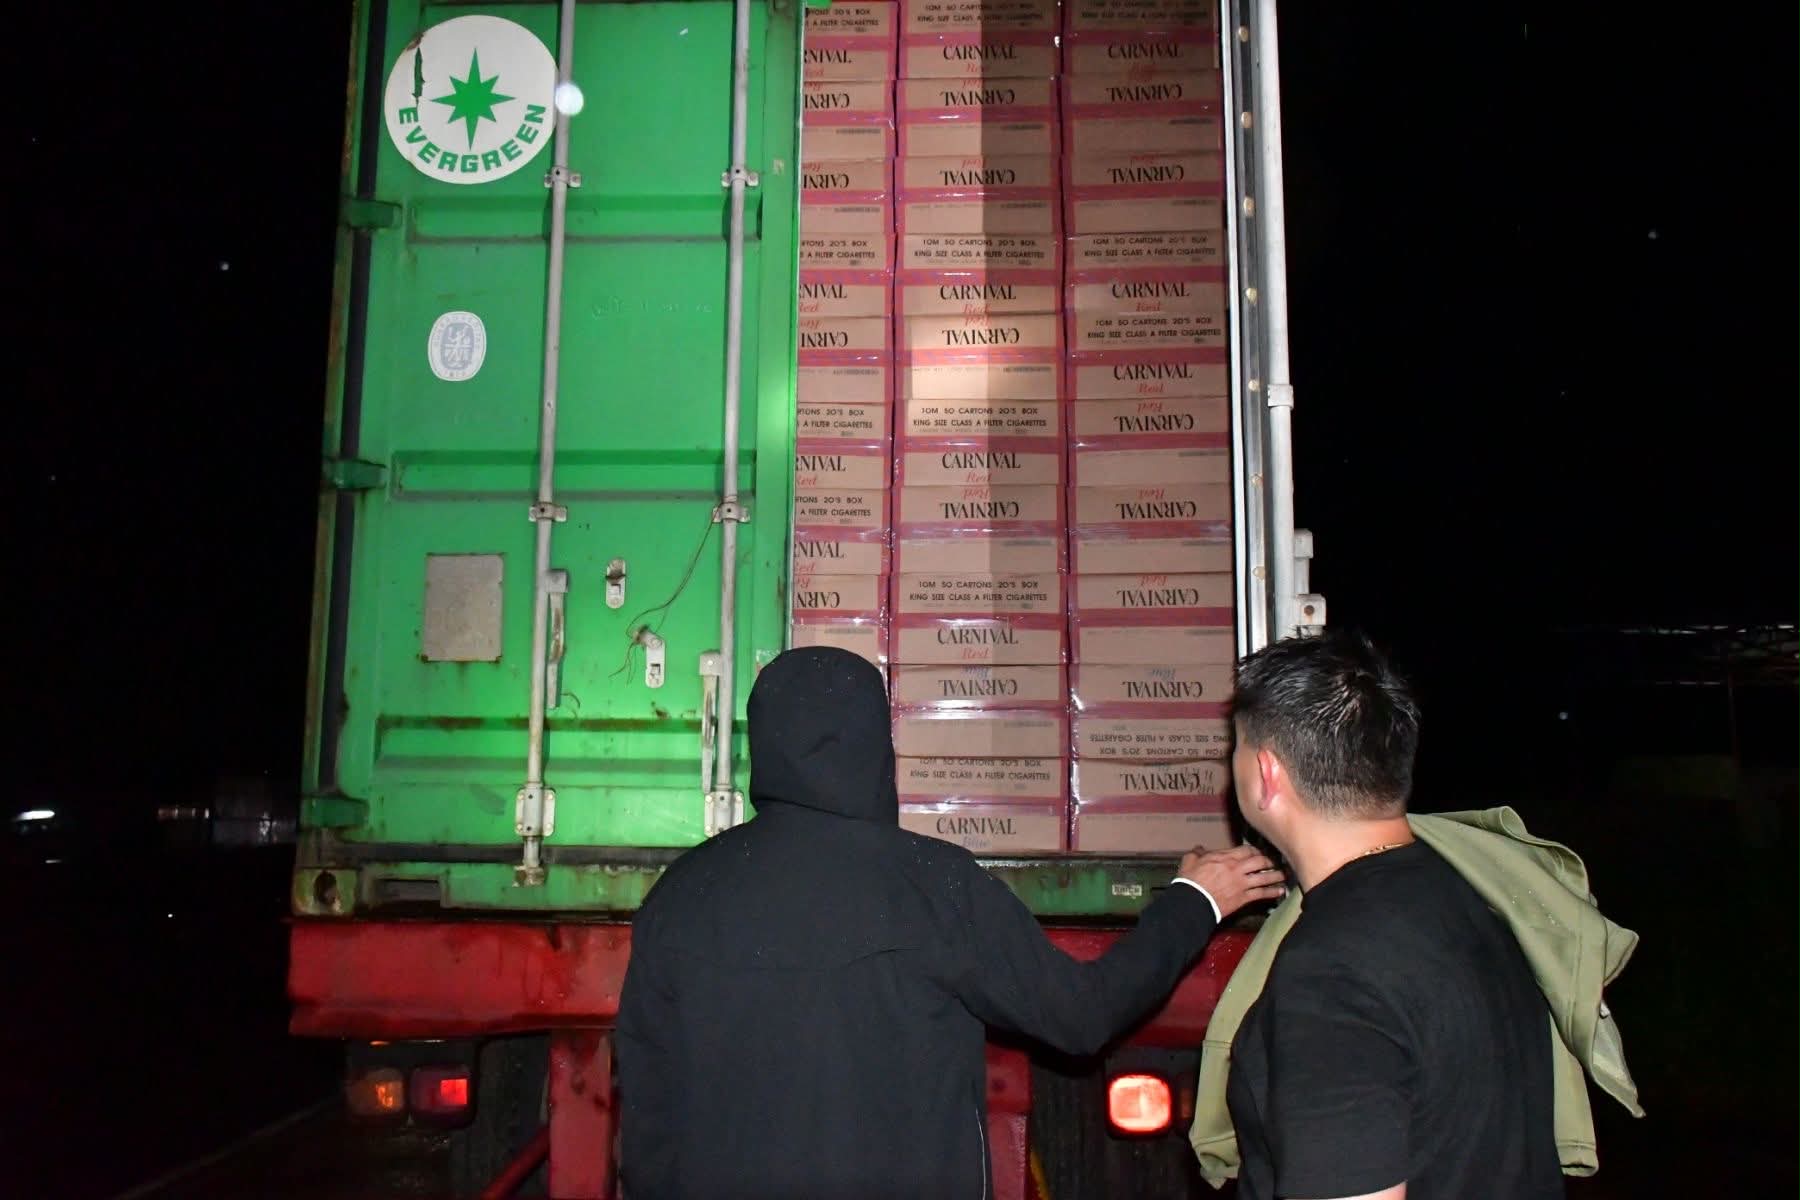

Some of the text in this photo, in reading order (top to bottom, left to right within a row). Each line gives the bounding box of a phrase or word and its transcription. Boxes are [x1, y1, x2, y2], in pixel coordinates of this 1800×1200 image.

[943, 45, 1017, 61] CARNIVAL
[1108, 42, 1184, 59] CARNIVAL
[804, 93, 850, 109] CARNI
[940, 89, 1015, 107] CARNIVAL
[1106, 84, 1182, 102] CARNIVAL
[399, 104, 546, 173] EVERGREEN
[803, 173, 850, 189] CARNI
[940, 169, 1015, 186] CARNIVAL
[1107, 165, 1184, 184] CARNIVAL
[959, 239, 993, 247] CARTONS
[1005, 251, 1045, 259] CIGARETTES
[1176, 248, 1216, 256] CIGARETTES
[940, 285, 1016, 301] CARNIVAL
[1111, 281, 1190, 299] CARNIVAL
[801, 331, 848, 348] CARNI
[942, 328, 1020, 346] CARNIVAL
[1181, 329, 1221, 337] CIGARETTES
[1113, 362, 1193, 381] CARNIVAL
[834, 421, 872, 429] CIGARETTES
[1006, 420, 1047, 428] CIGARETTES
[1113, 414, 1194, 433] CARNIVAL
[942, 452, 1021, 469] CARNIVAL
[966, 472, 992, 482] Red
[831, 509, 871, 517] CIGARETTES
[940, 501, 1020, 519] CARNIVAL
[1115, 501, 1197, 519] CARNIVAL
[797, 591, 840, 608] CARN
[1005, 593, 1047, 601] CIGARETTES
[1116, 588, 1199, 607] CARNIVAL
[937, 628, 1019, 645] CARNIVAL
[961, 650, 990, 660] Red
[938, 679, 1018, 697] CARNIVAL
[1122, 681, 1203, 698] CARNIVAL
[910, 770, 929, 778] KING
[950, 771, 973, 779] CLASS
[984, 771, 1005, 779] FILTER
[1008, 772, 1050, 780] CIGARETTES
[1120, 773, 1200, 790] CARNIVAL
[936, 816, 1017, 835] CARNIVAL
